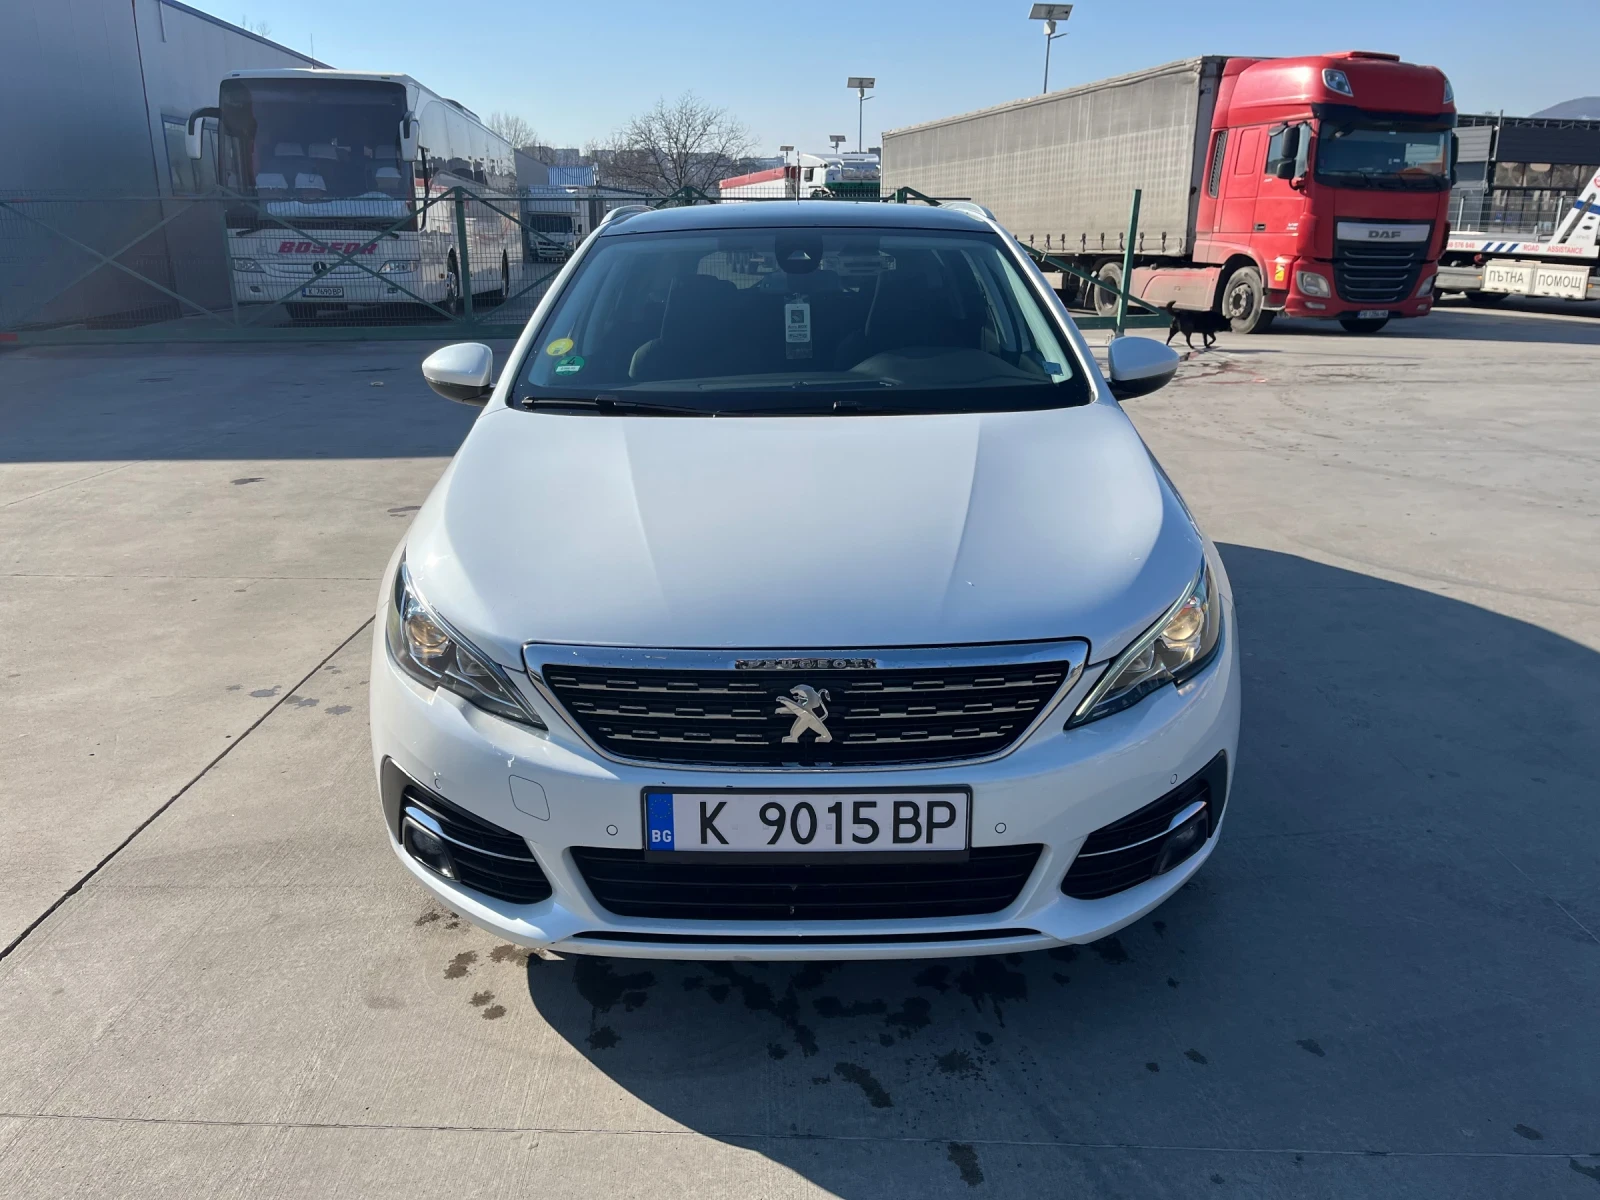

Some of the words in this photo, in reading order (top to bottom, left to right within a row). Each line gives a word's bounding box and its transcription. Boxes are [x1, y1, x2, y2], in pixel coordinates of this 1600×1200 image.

[1368, 230, 1401, 239] DAF
[1523, 244, 1540, 252] ROAD
[1546, 245, 1584, 255] ASSISTANCE
[1490, 270, 1524, 284] ПЪТНА
[1538, 274, 1582, 291] ПОМОЩ
[567, 356, 577, 366] 4
[746, 659, 864, 669] PEUGEOT
[699, 801, 730, 845] K
[651, 829, 673, 843] BG
